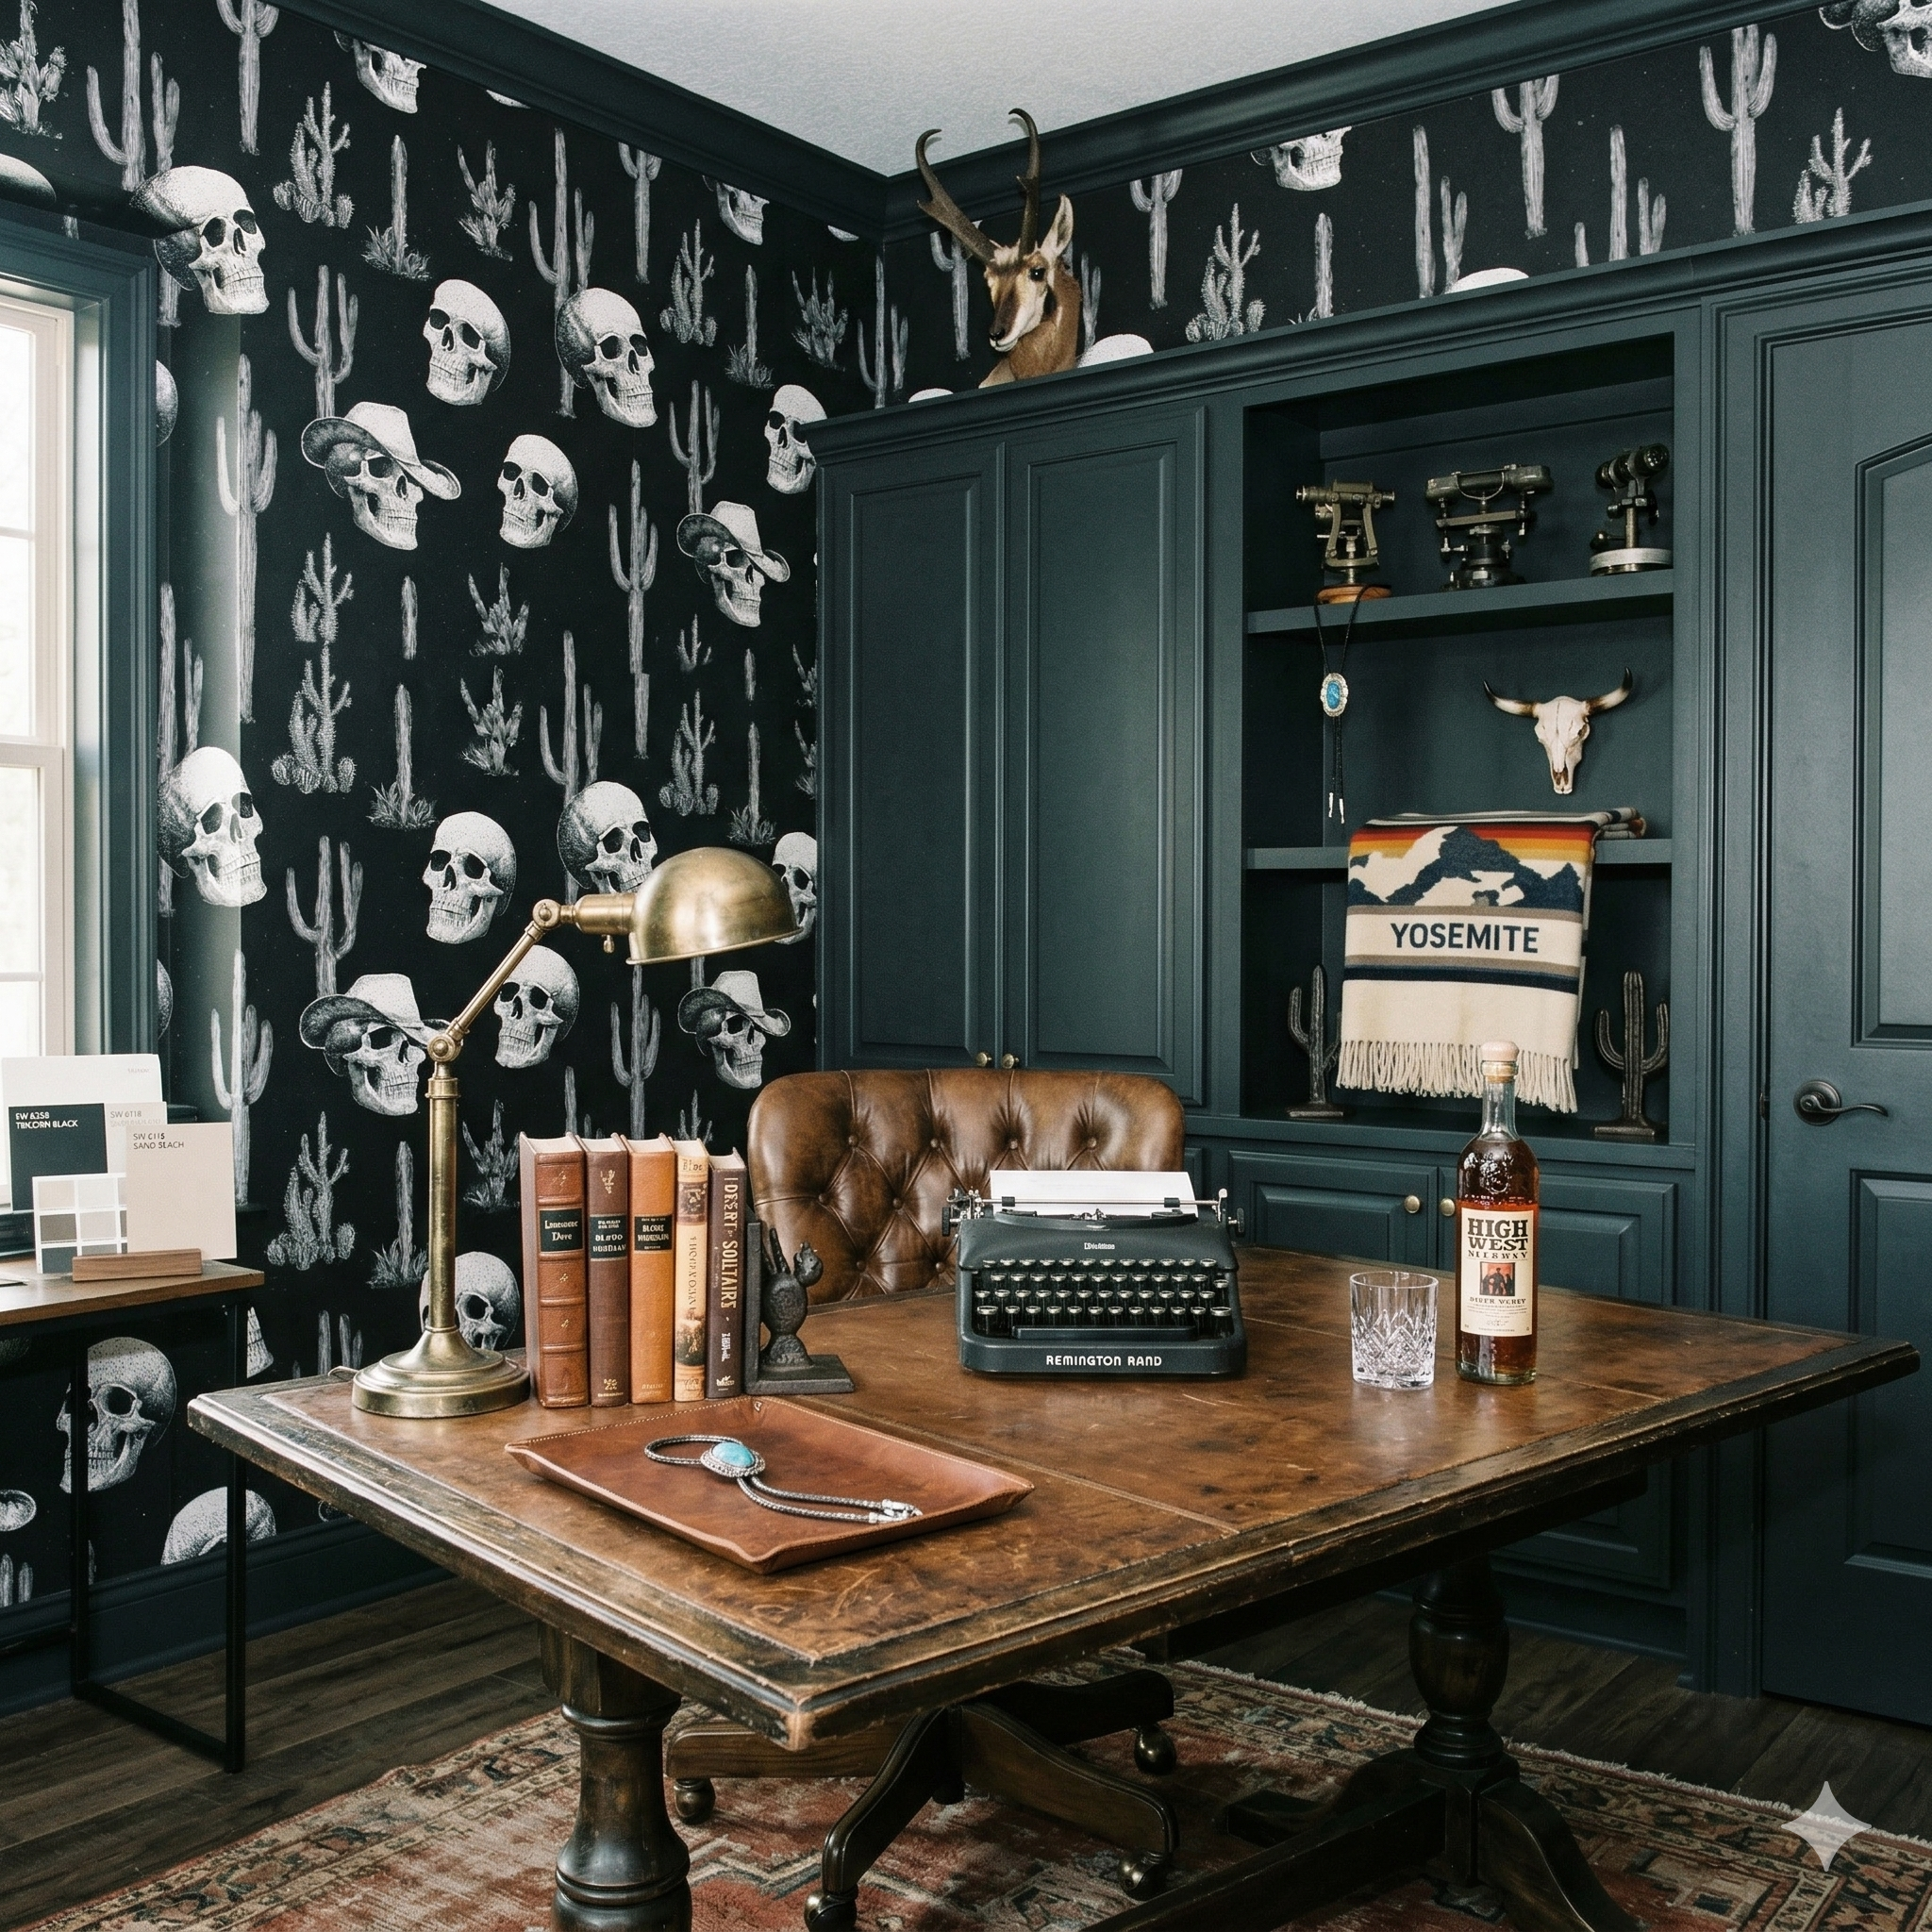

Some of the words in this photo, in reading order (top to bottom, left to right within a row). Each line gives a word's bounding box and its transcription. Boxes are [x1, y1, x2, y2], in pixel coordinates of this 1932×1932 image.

[1391, 923, 1540, 953] YOSEMITE
[1467, 1218, 1528, 1238] HIGH
[1468, 1236, 1528, 1251] WEST
[1046, 1356, 1122, 1367] REMINGTON
[1127, 1356, 1162, 1367] RAND
